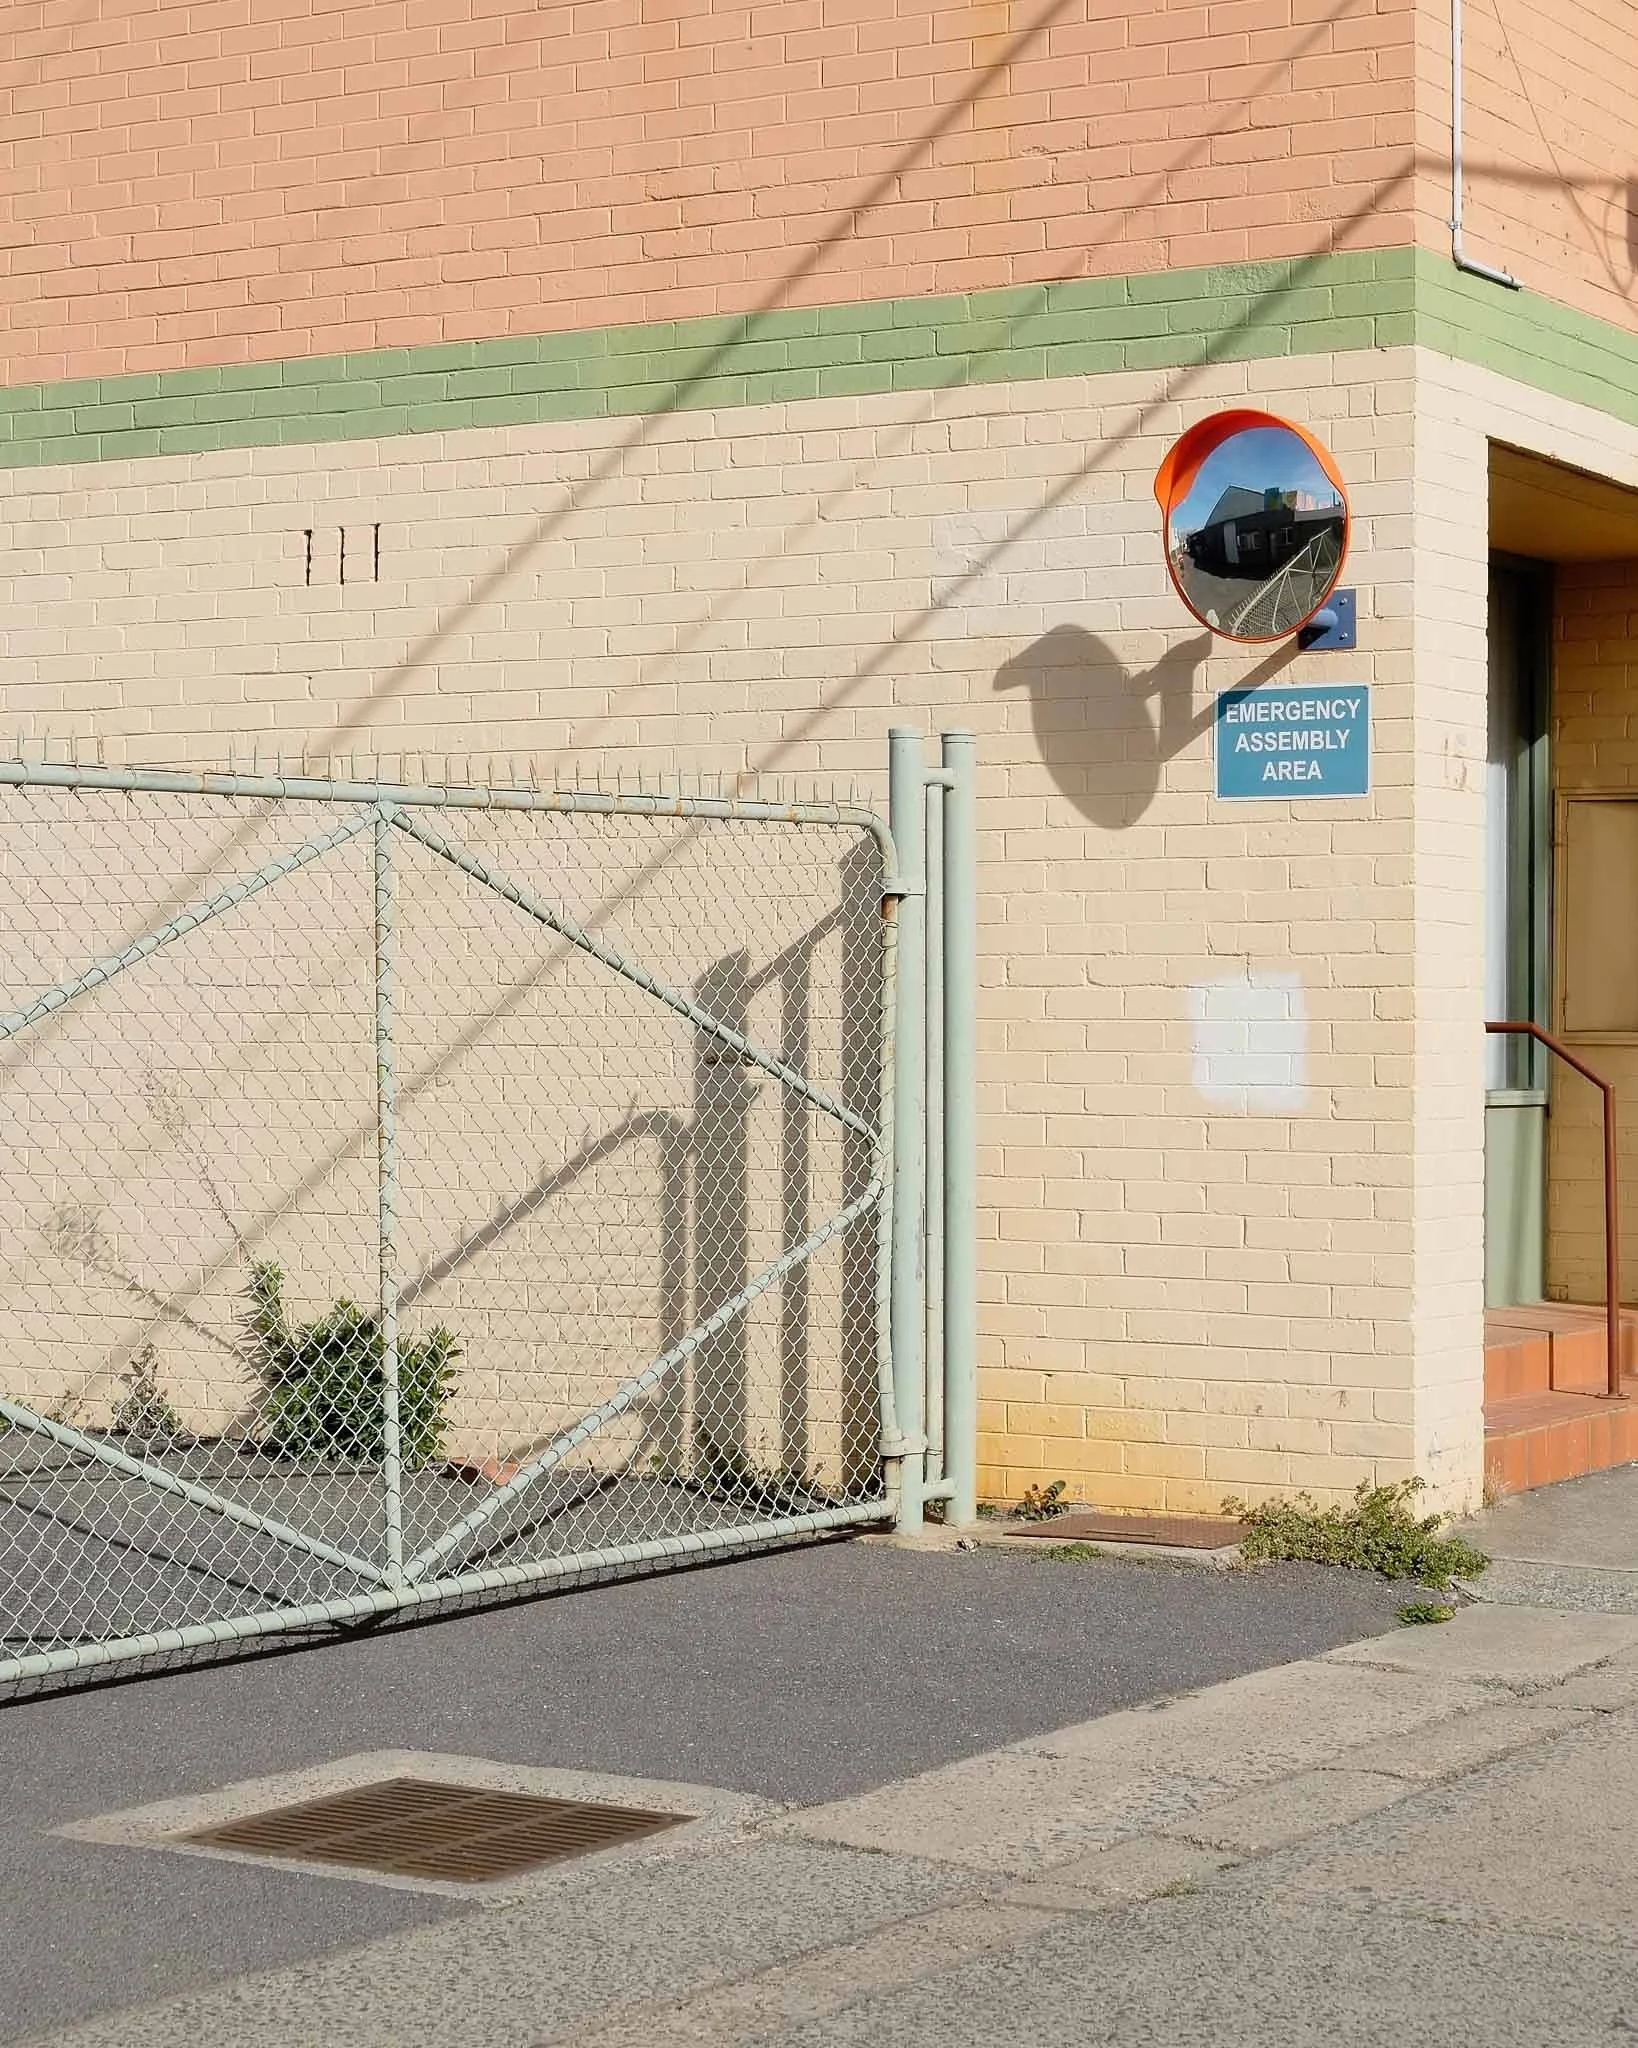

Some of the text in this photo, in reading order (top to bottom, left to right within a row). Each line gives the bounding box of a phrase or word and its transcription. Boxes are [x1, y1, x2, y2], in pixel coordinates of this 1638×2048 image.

[1225, 699, 1361, 723] EMERGENCY
[1234, 729, 1351, 752] ASSEMBLY
[1262, 760, 1323, 781] AREA
